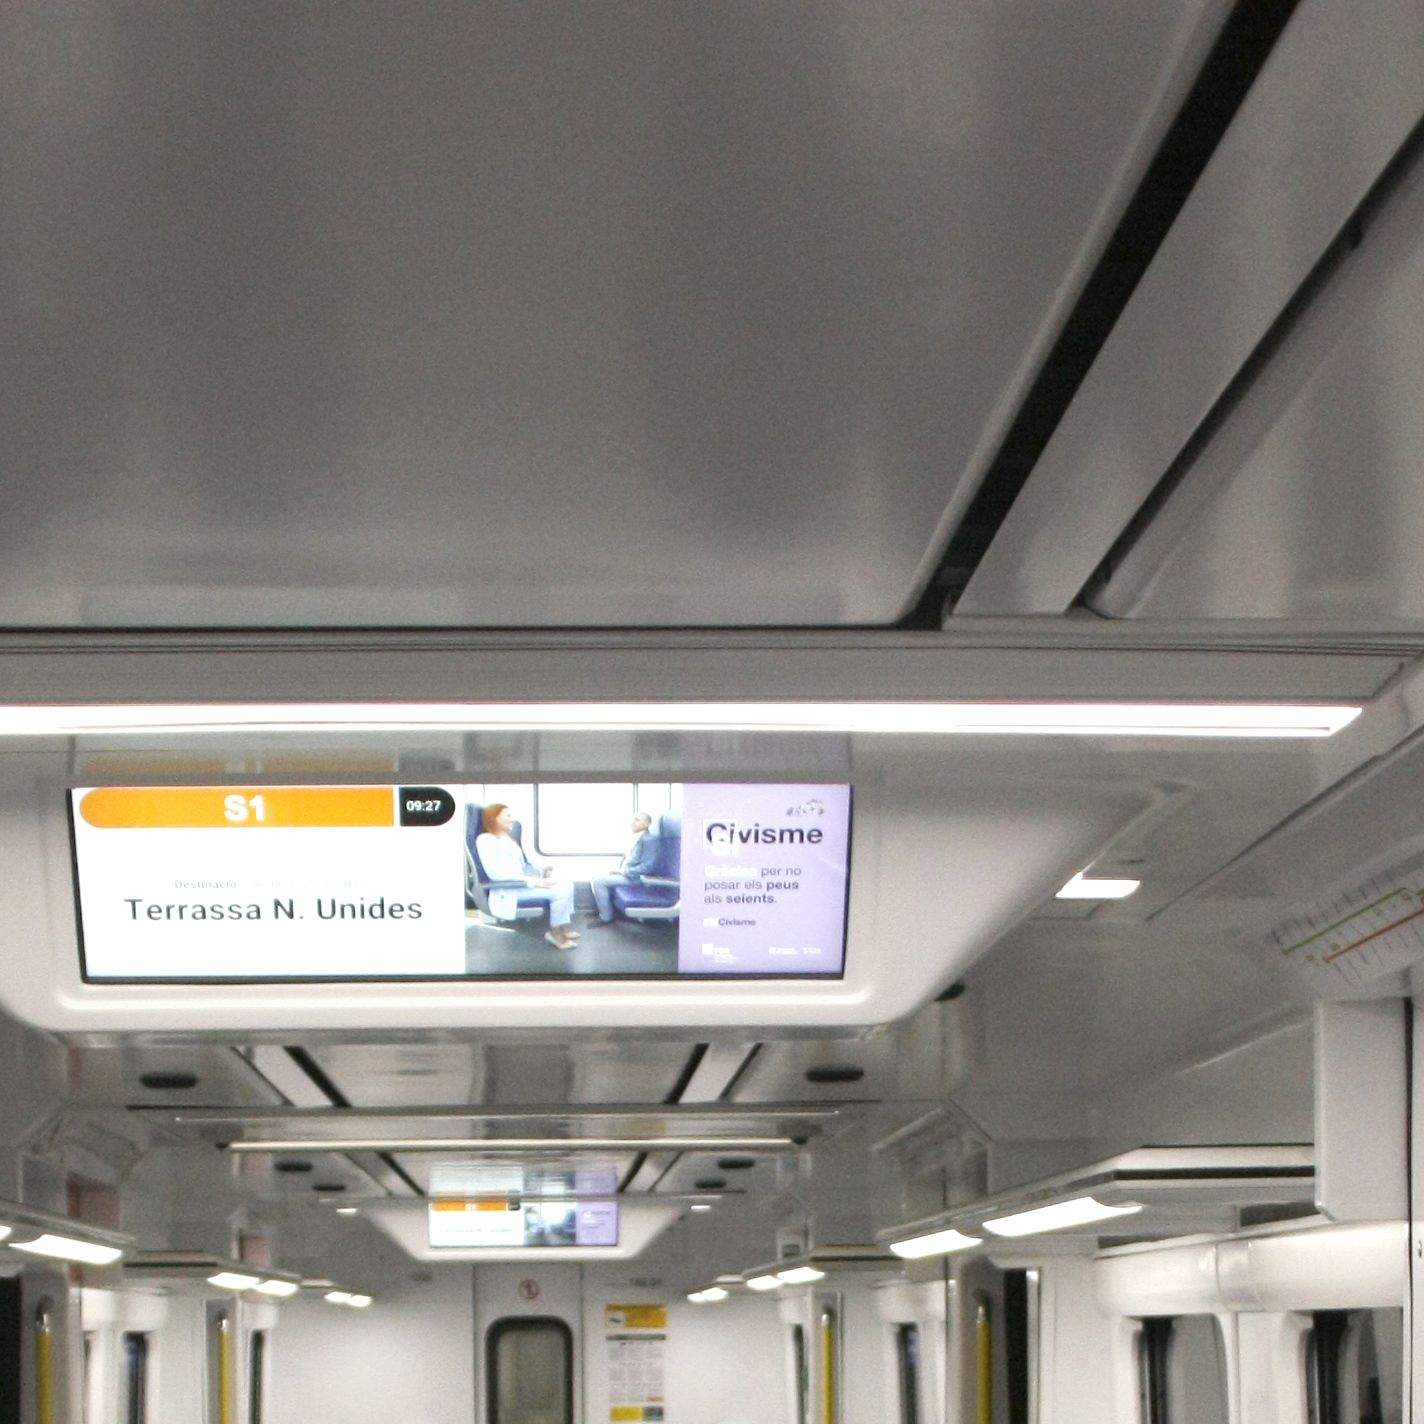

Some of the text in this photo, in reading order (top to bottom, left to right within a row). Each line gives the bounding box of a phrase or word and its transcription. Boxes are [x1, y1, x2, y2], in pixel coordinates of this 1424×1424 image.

[223, 794, 266, 822] S1
[405, 800, 442, 812] 09:27
[705, 822, 824, 845] Civisme
[760, 867, 782, 878] per
[785, 867, 803, 877] no
[704, 880, 800, 892] posar els peus
[704, 893, 778, 904] als seients.
[124, 896, 423, 921] Terrassa N. Unides
